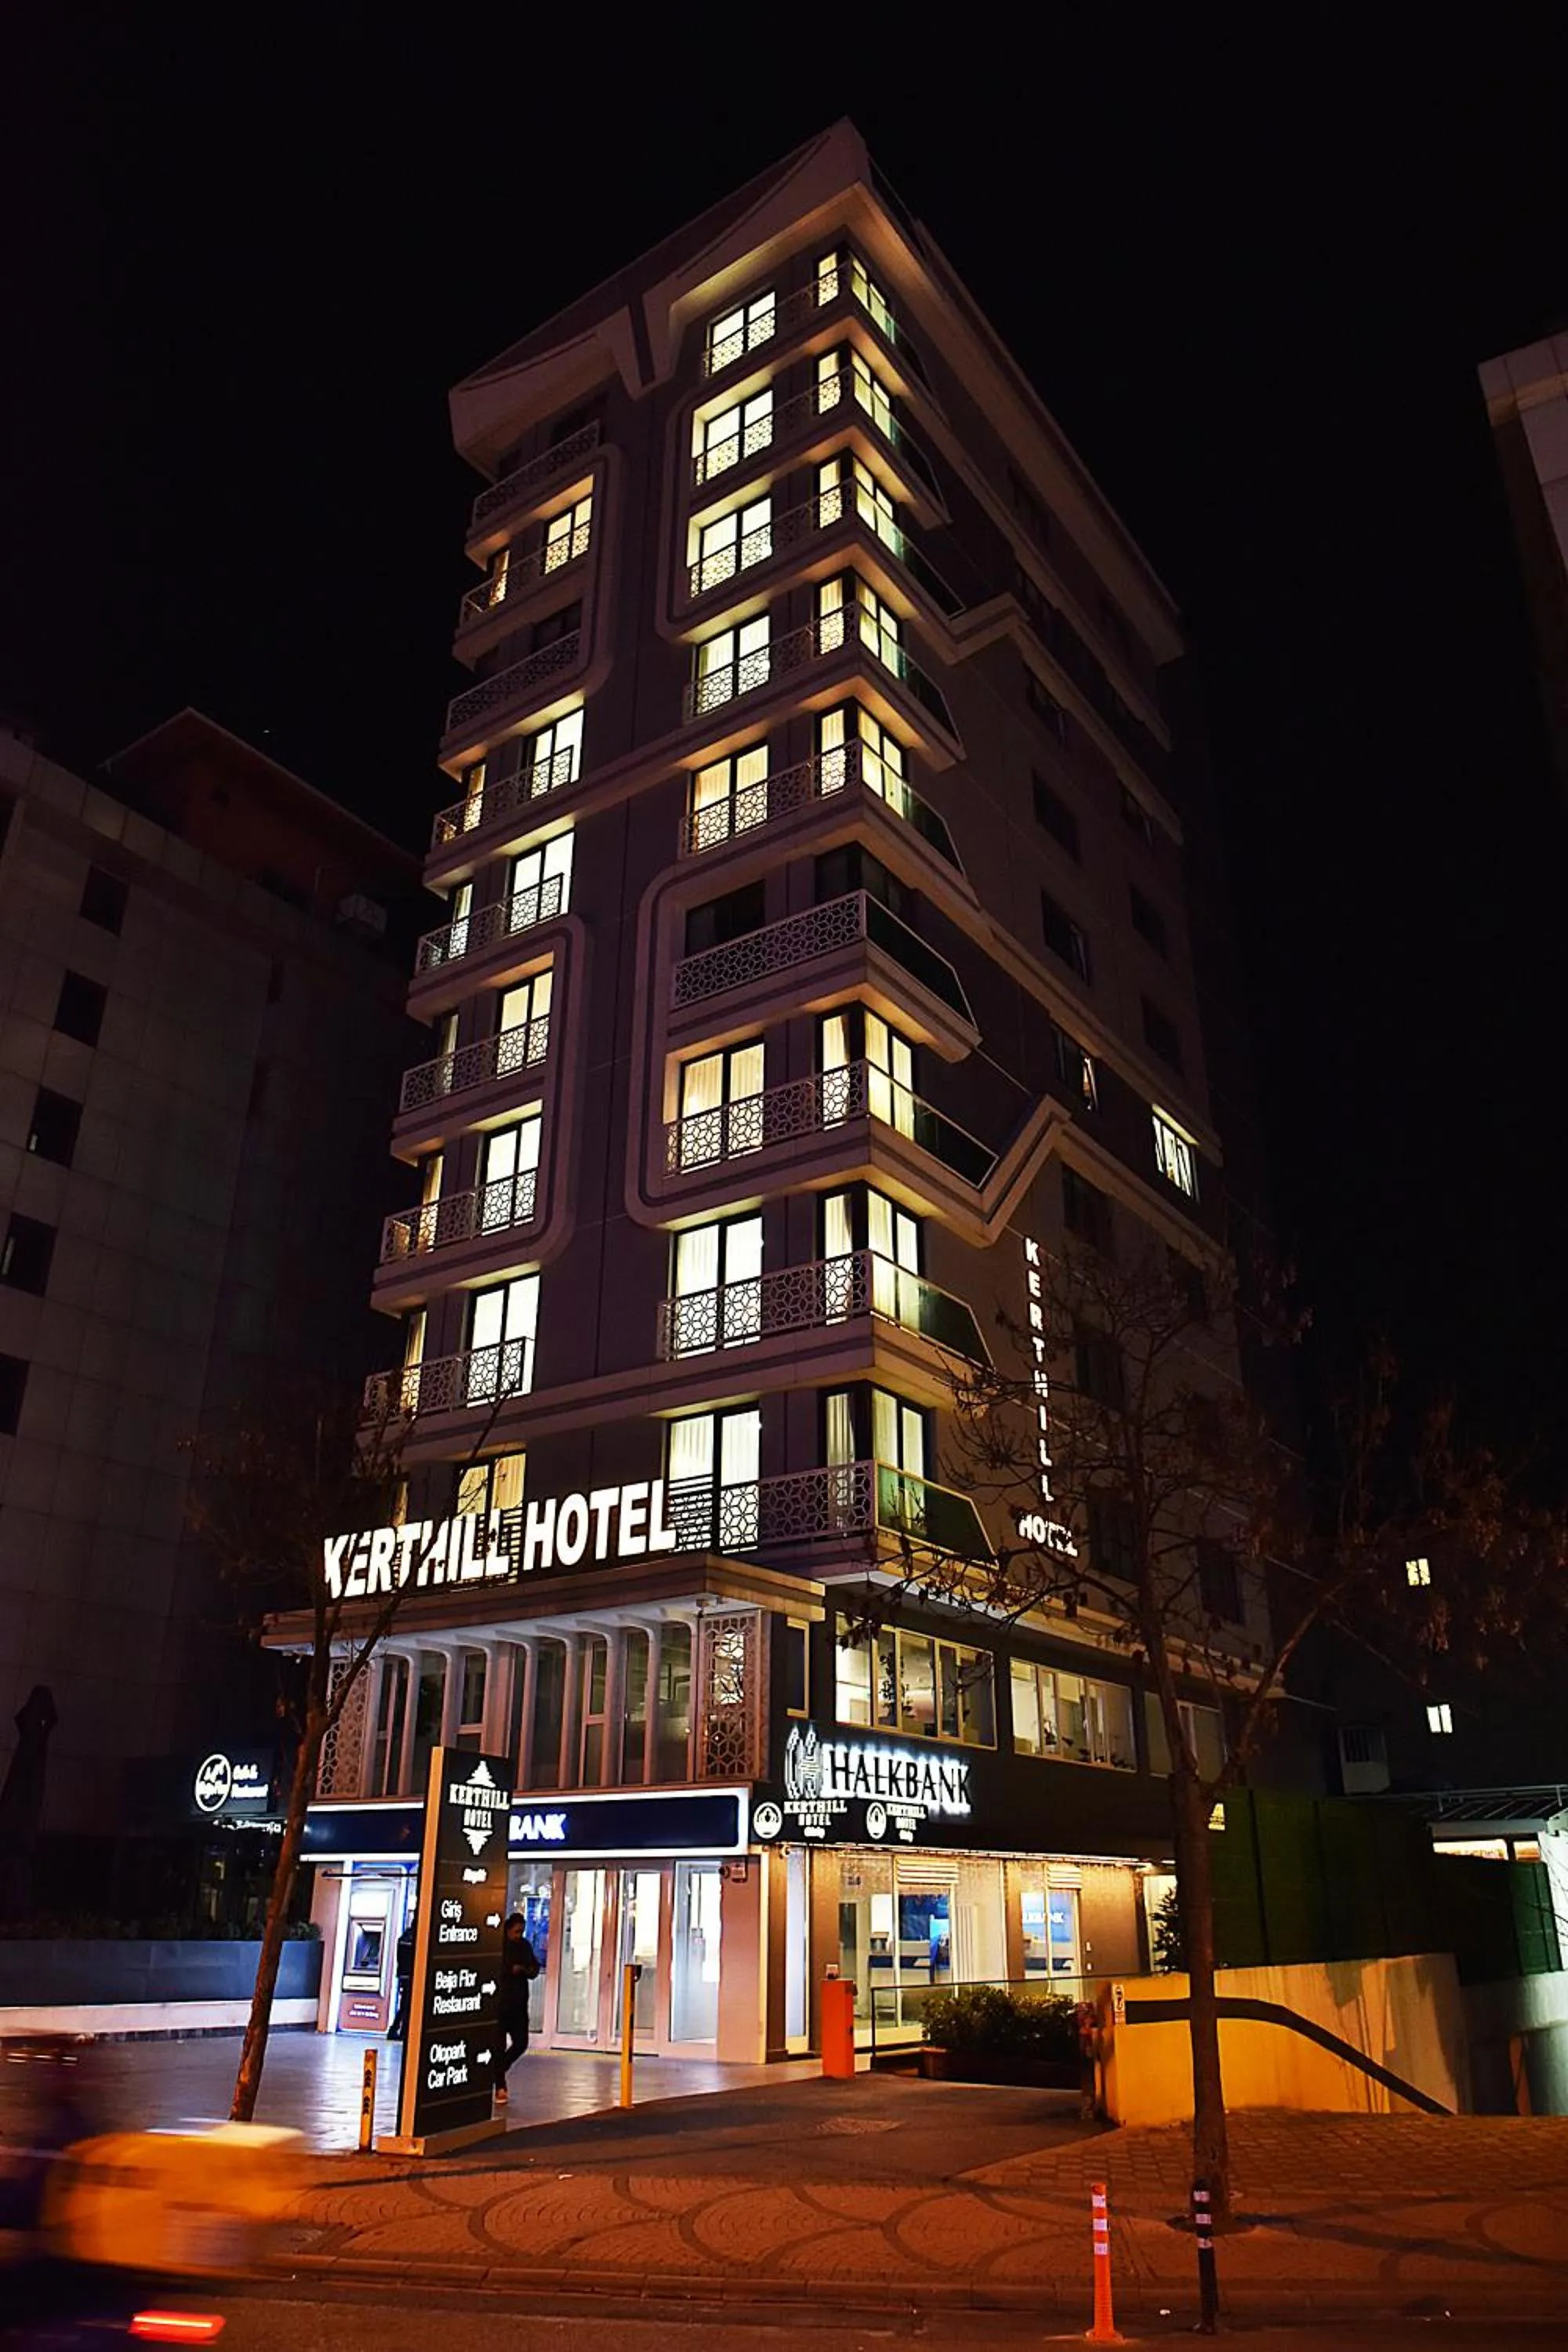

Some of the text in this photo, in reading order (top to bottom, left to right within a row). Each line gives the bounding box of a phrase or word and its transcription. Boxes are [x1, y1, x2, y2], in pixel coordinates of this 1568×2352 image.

[1025, 1238, 1054, 1501] KERTHILL
[324, 1479, 677, 1599] KERTHILL HOTEL
[829, 1750, 971, 1806] HALKBANK
[449, 1784, 510, 1810] KERTHILL
[463, 1809, 492, 1828] HOTEL
[441, 1900, 462, 1922] Giriş
[439, 1924, 477, 1943] Entrance
[459, 1969, 477, 1987] Flor
[433, 1993, 481, 2015] Restaurant
[430, 2040, 466, 2065] Otopark
[427, 2064, 468, 2089] Car Park
